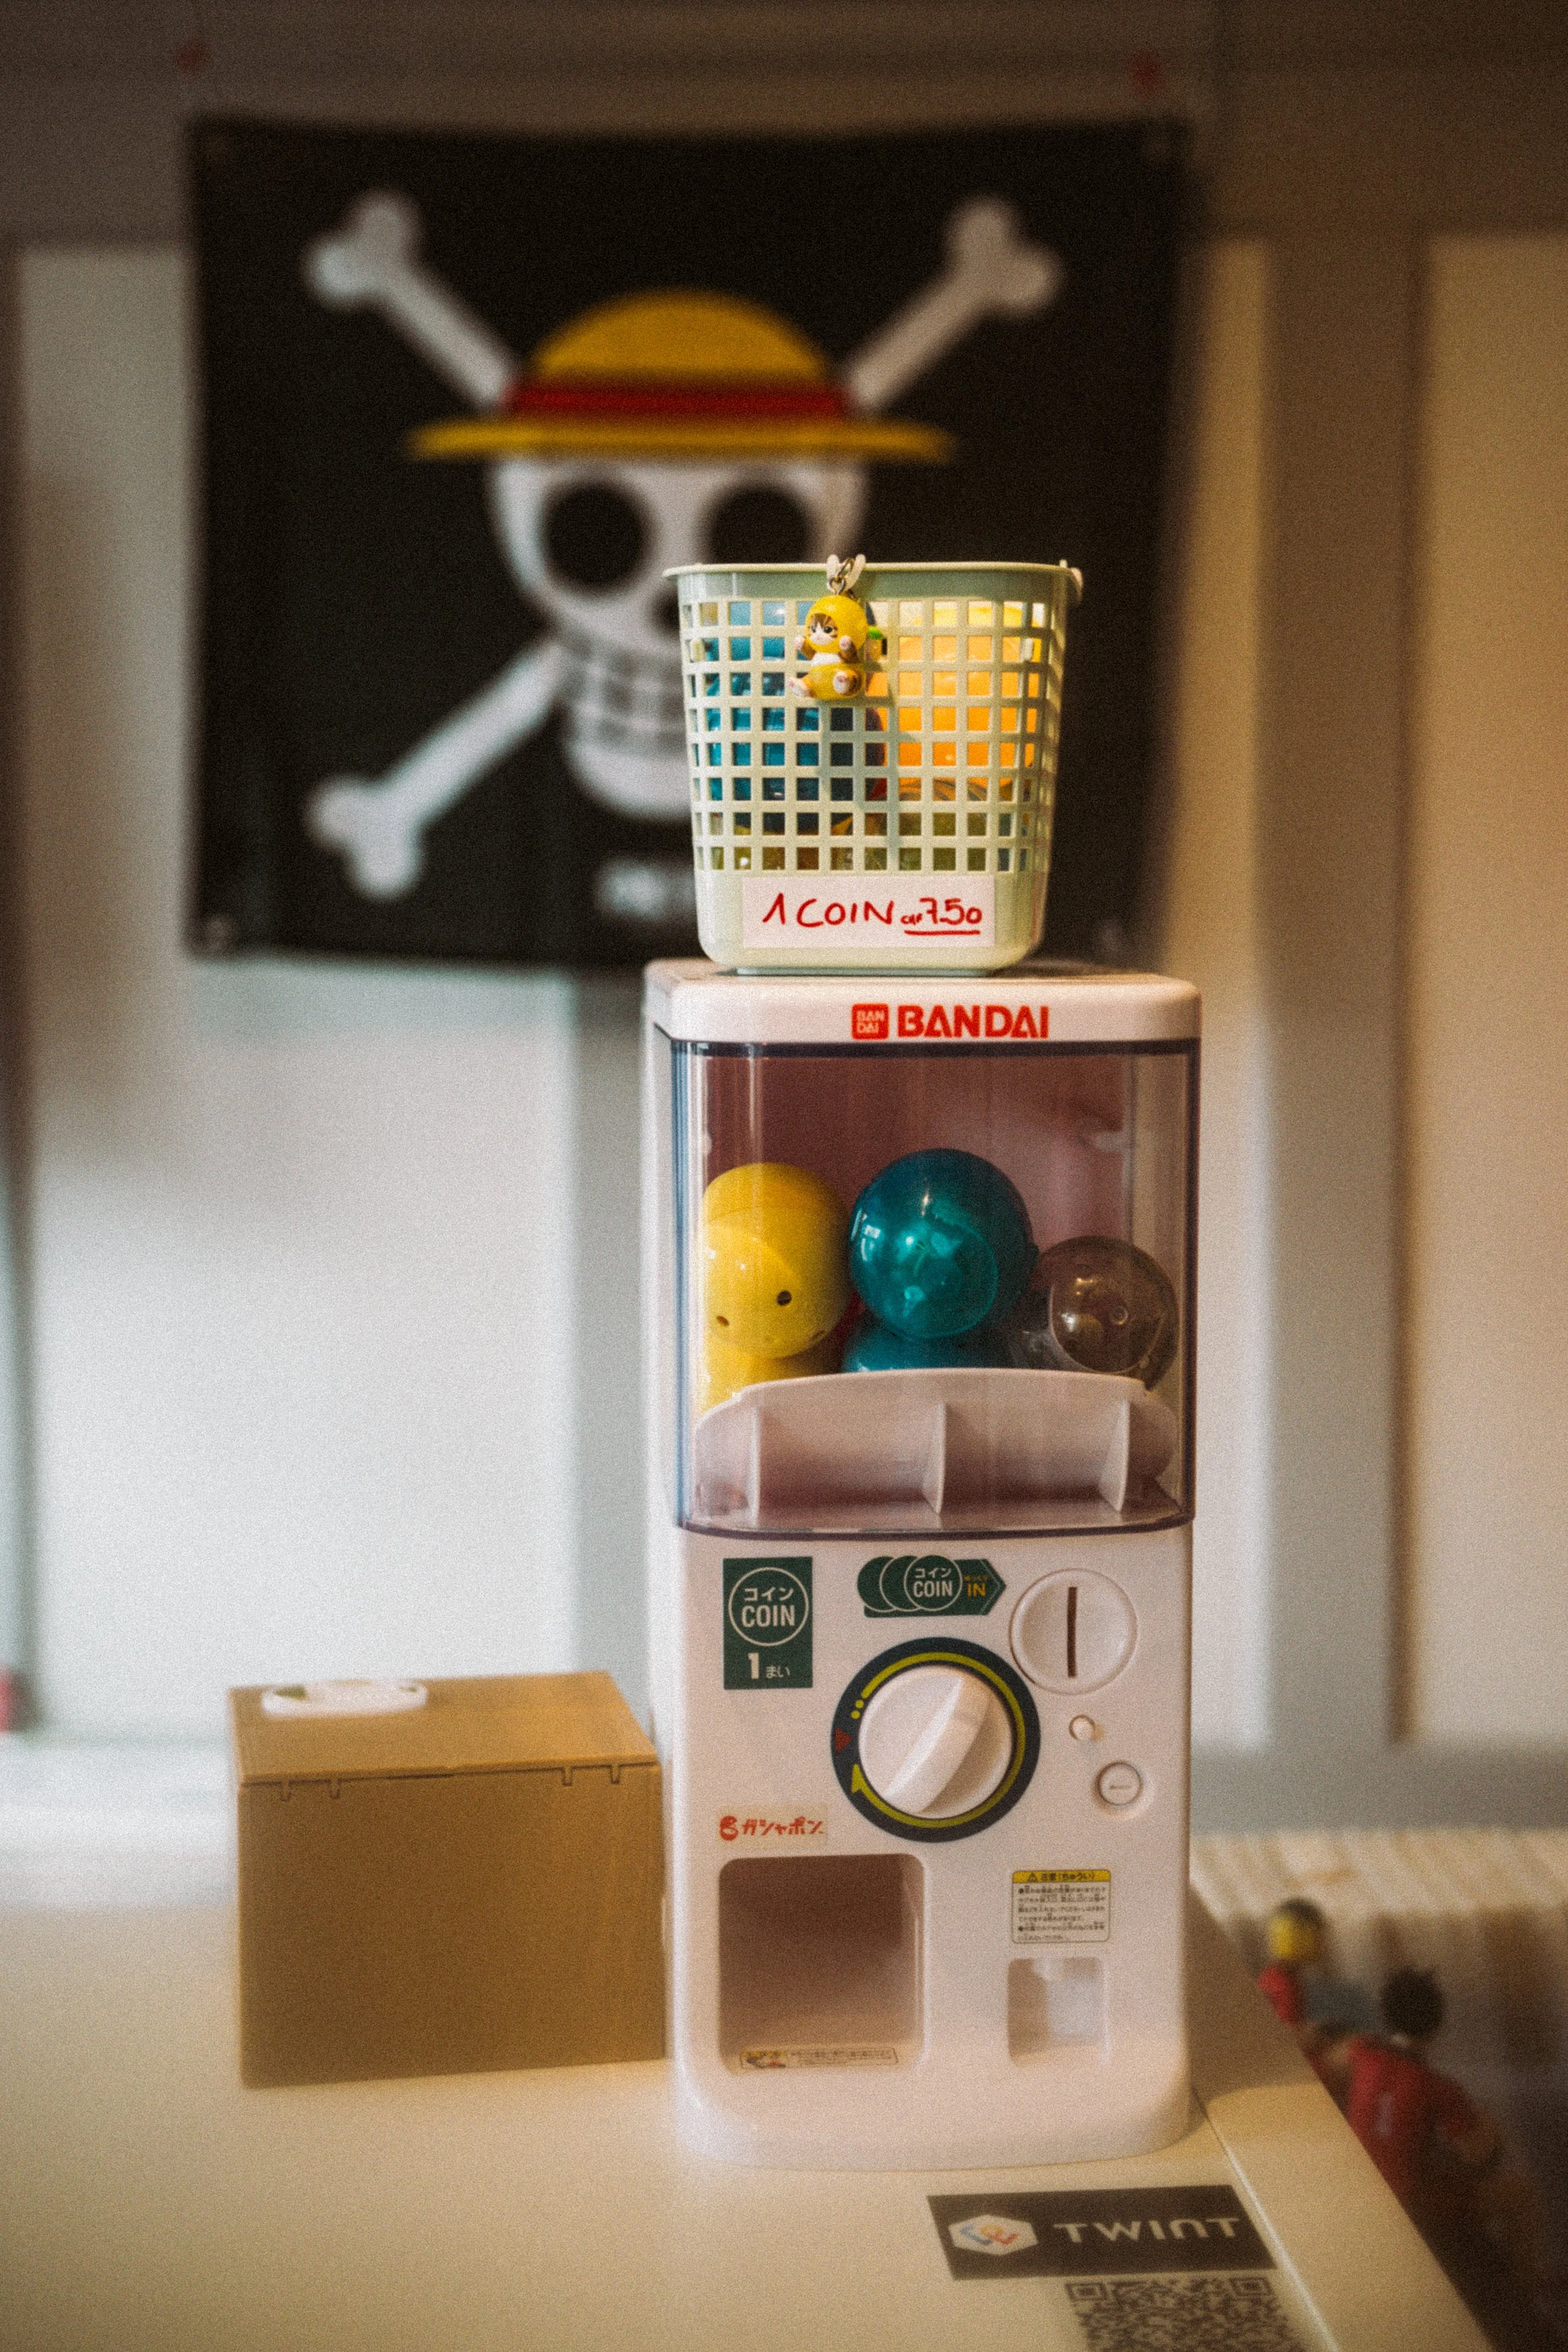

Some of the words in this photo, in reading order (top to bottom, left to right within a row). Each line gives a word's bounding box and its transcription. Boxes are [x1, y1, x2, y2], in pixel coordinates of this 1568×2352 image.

[762, 892, 786, 925] 1
[796, 898, 894, 928] COIN
[897, 1004, 1050, 1038] BANDAI
[914, 1567, 952, 1579] コイン
[744, 1586, 794, 1602] コイン
[913, 1580, 953, 1598] COIN
[967, 1582, 987, 1597] IN
[741, 1604, 795, 1628] COIN
